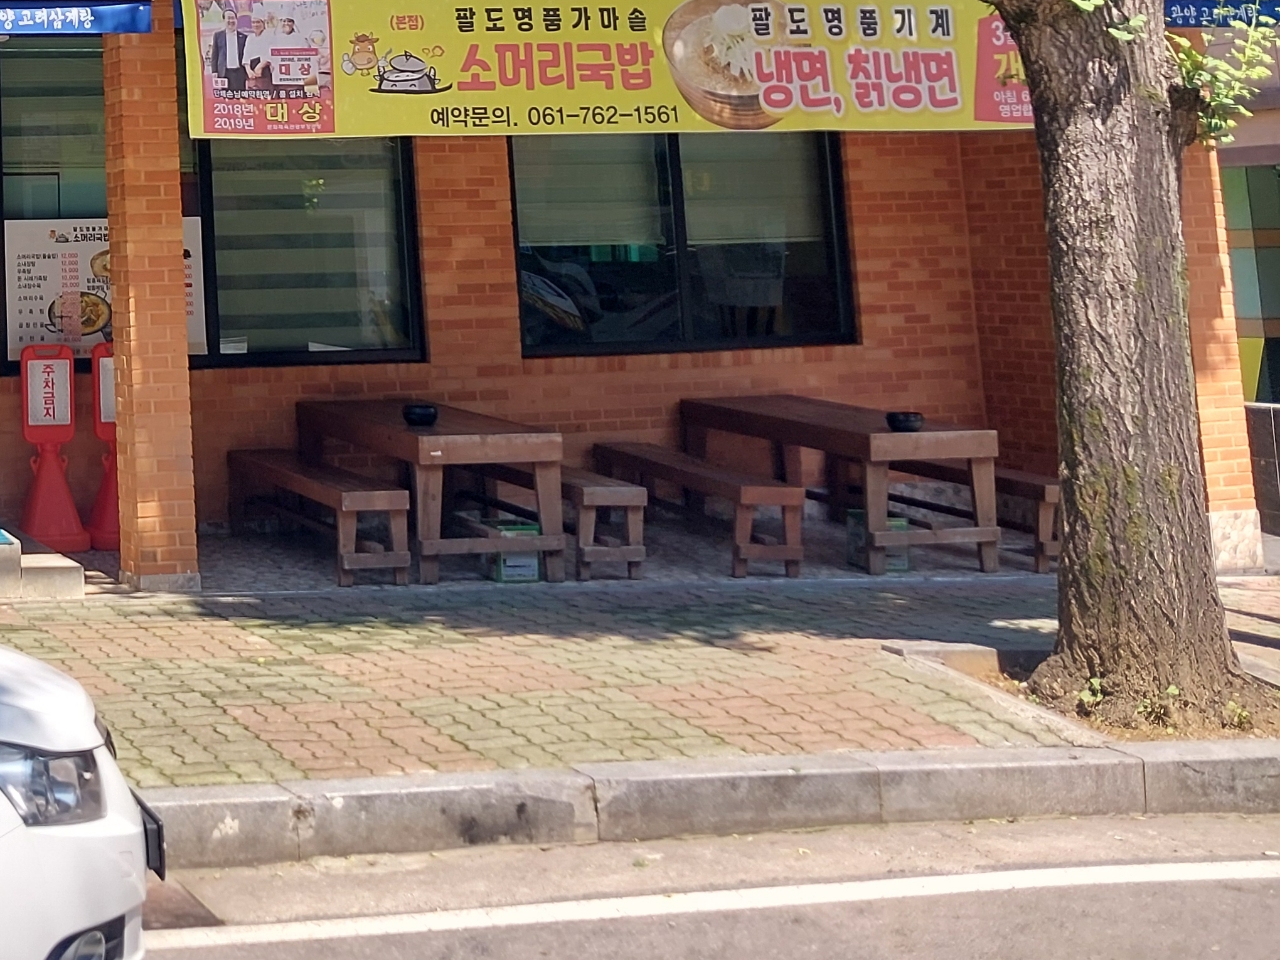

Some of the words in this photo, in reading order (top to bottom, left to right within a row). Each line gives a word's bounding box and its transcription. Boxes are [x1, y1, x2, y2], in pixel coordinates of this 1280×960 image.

[19, 10, 95, 32] 고려삼계탕
[389, 13, 425, 32] (본점)
[456, 41, 655, 93] 소머리국밥
[754, 50, 843, 116] 냉면,
[848, 48, 959, 111] 칡냉면
[213, 103, 254, 116] 2018년
[527, 104, 680, 127] 061-762-1561
[214, 117, 255, 130] 2019년
[42, 364, 56, 420] 주차금지
